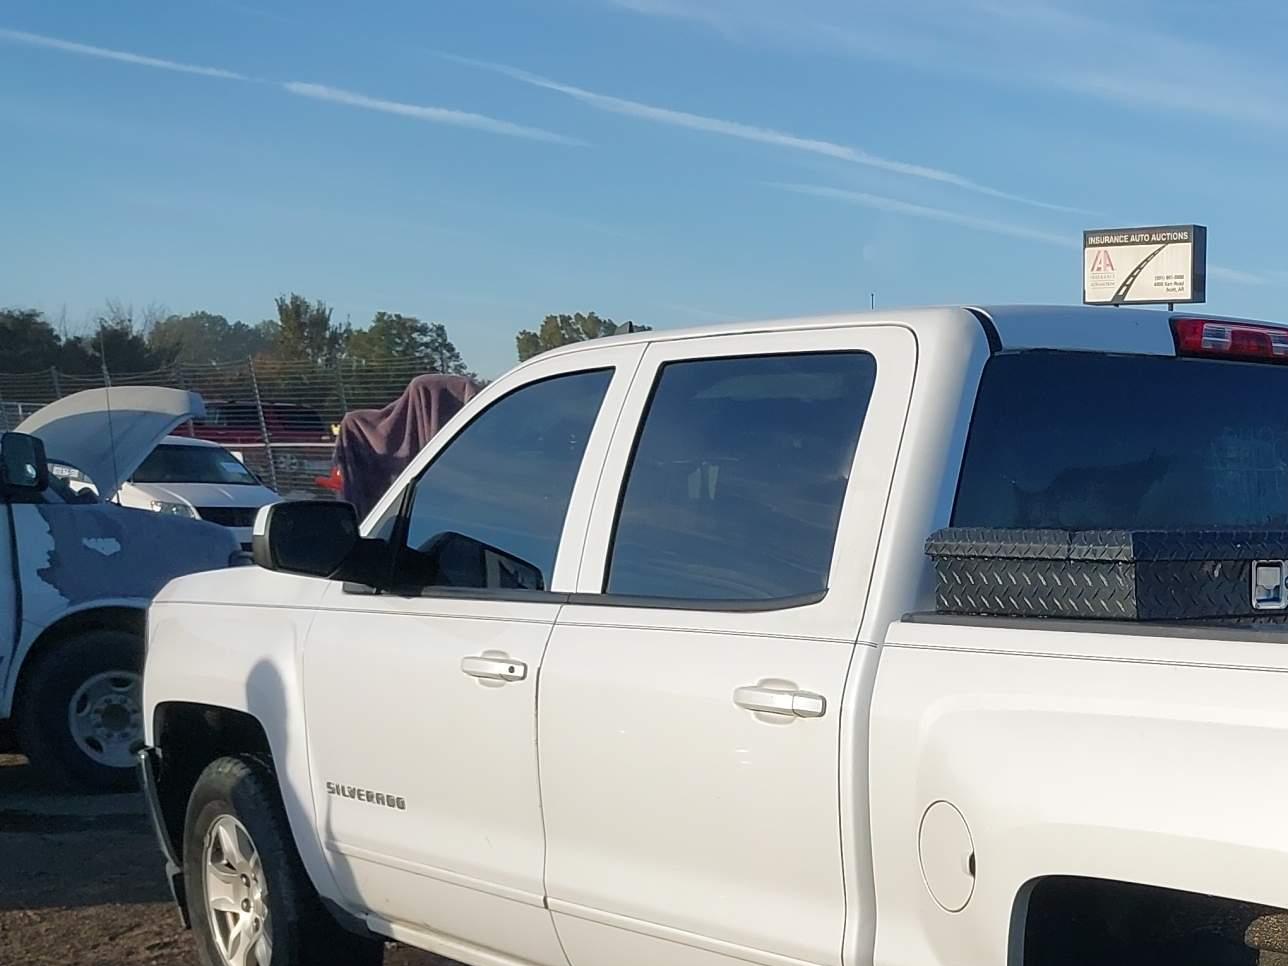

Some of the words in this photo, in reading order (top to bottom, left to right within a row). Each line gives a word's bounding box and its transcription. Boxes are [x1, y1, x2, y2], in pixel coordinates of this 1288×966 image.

[1088, 234, 1129, 245] INSURANCE
[1130, 233, 1150, 243] AUTO
[1151, 231, 1189, 241] AUCTIONS
[326, 781, 406, 810] SILVERADO
